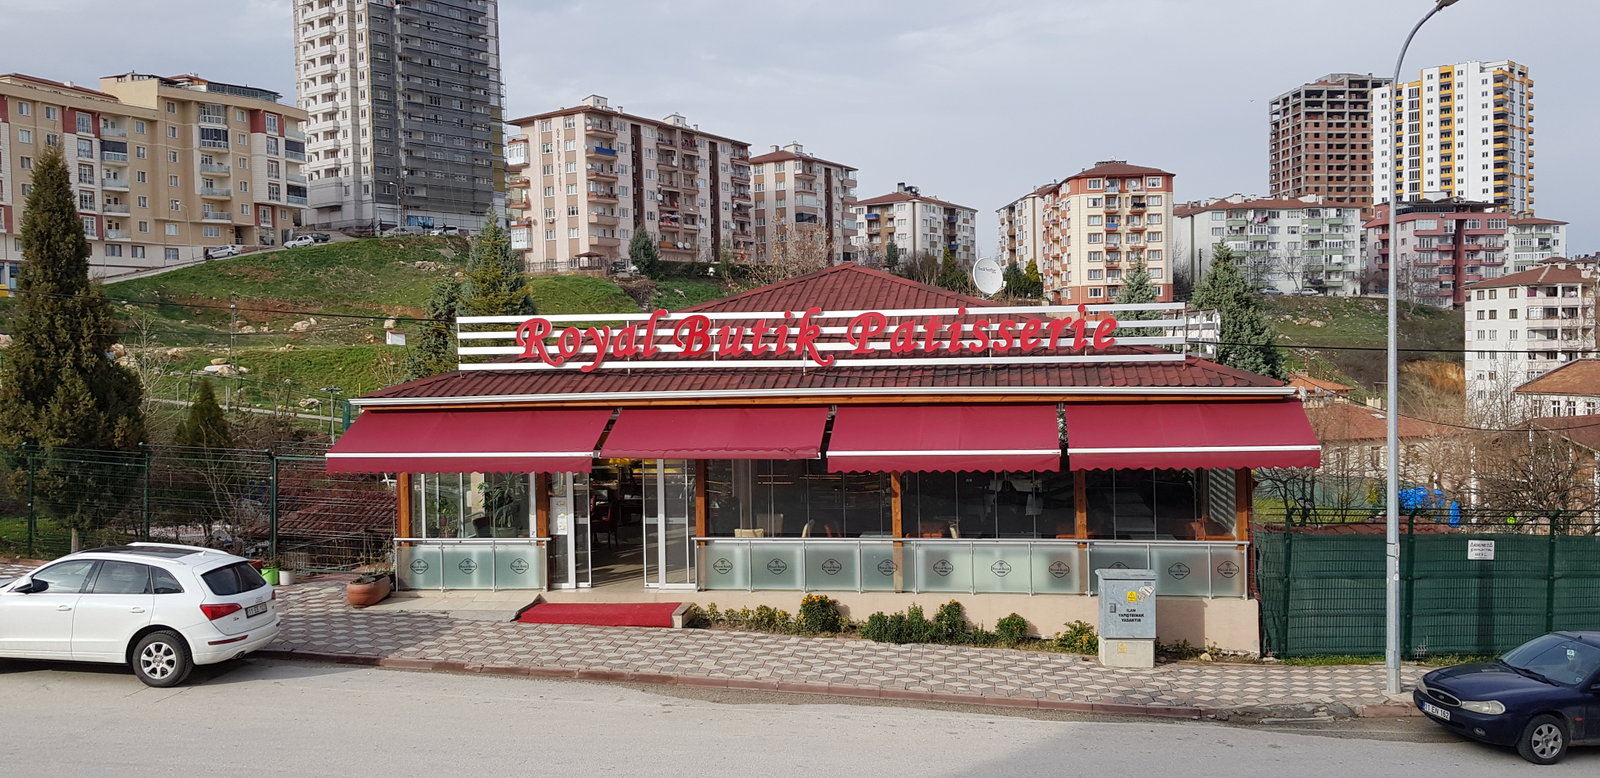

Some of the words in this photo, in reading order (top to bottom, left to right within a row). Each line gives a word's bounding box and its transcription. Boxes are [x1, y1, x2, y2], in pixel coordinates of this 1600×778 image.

[515, 308, 670, 373] Royal
[672, 306, 836, 367] Butik
[846, 303, 1118, 355] Patisserie
